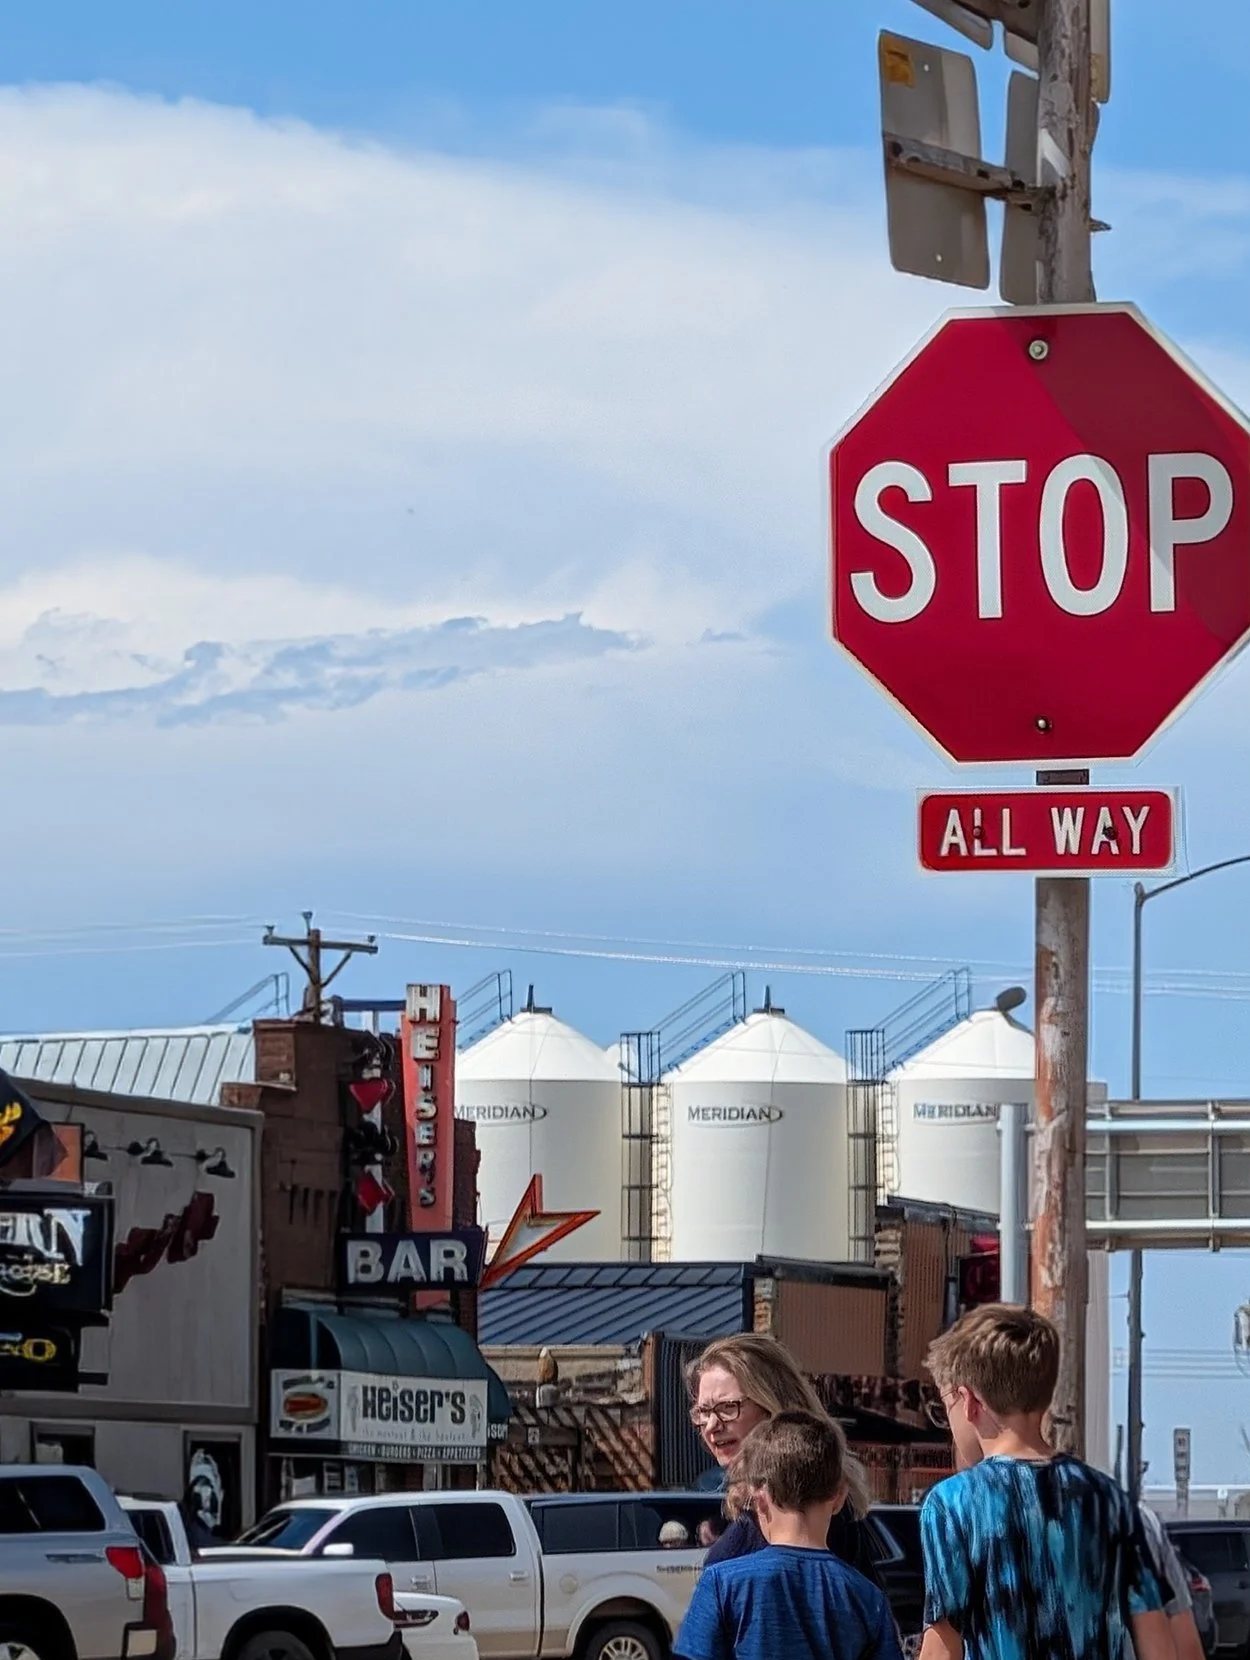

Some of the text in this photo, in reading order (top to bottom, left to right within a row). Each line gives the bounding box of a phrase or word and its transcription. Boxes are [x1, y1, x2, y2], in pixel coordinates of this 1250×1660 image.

[850, 452, 1234, 623] STOP
[940, 806, 1150, 856] ALL WAY
[455, 1105, 535, 1119] MERIDIAN
[687, 1106, 771, 1121] MERIDIAN
[913, 1103, 999, 1119] MERIDIAN
[347, 1239, 469, 1284] BAR
[361, 1383, 465, 1425] Heiser's
